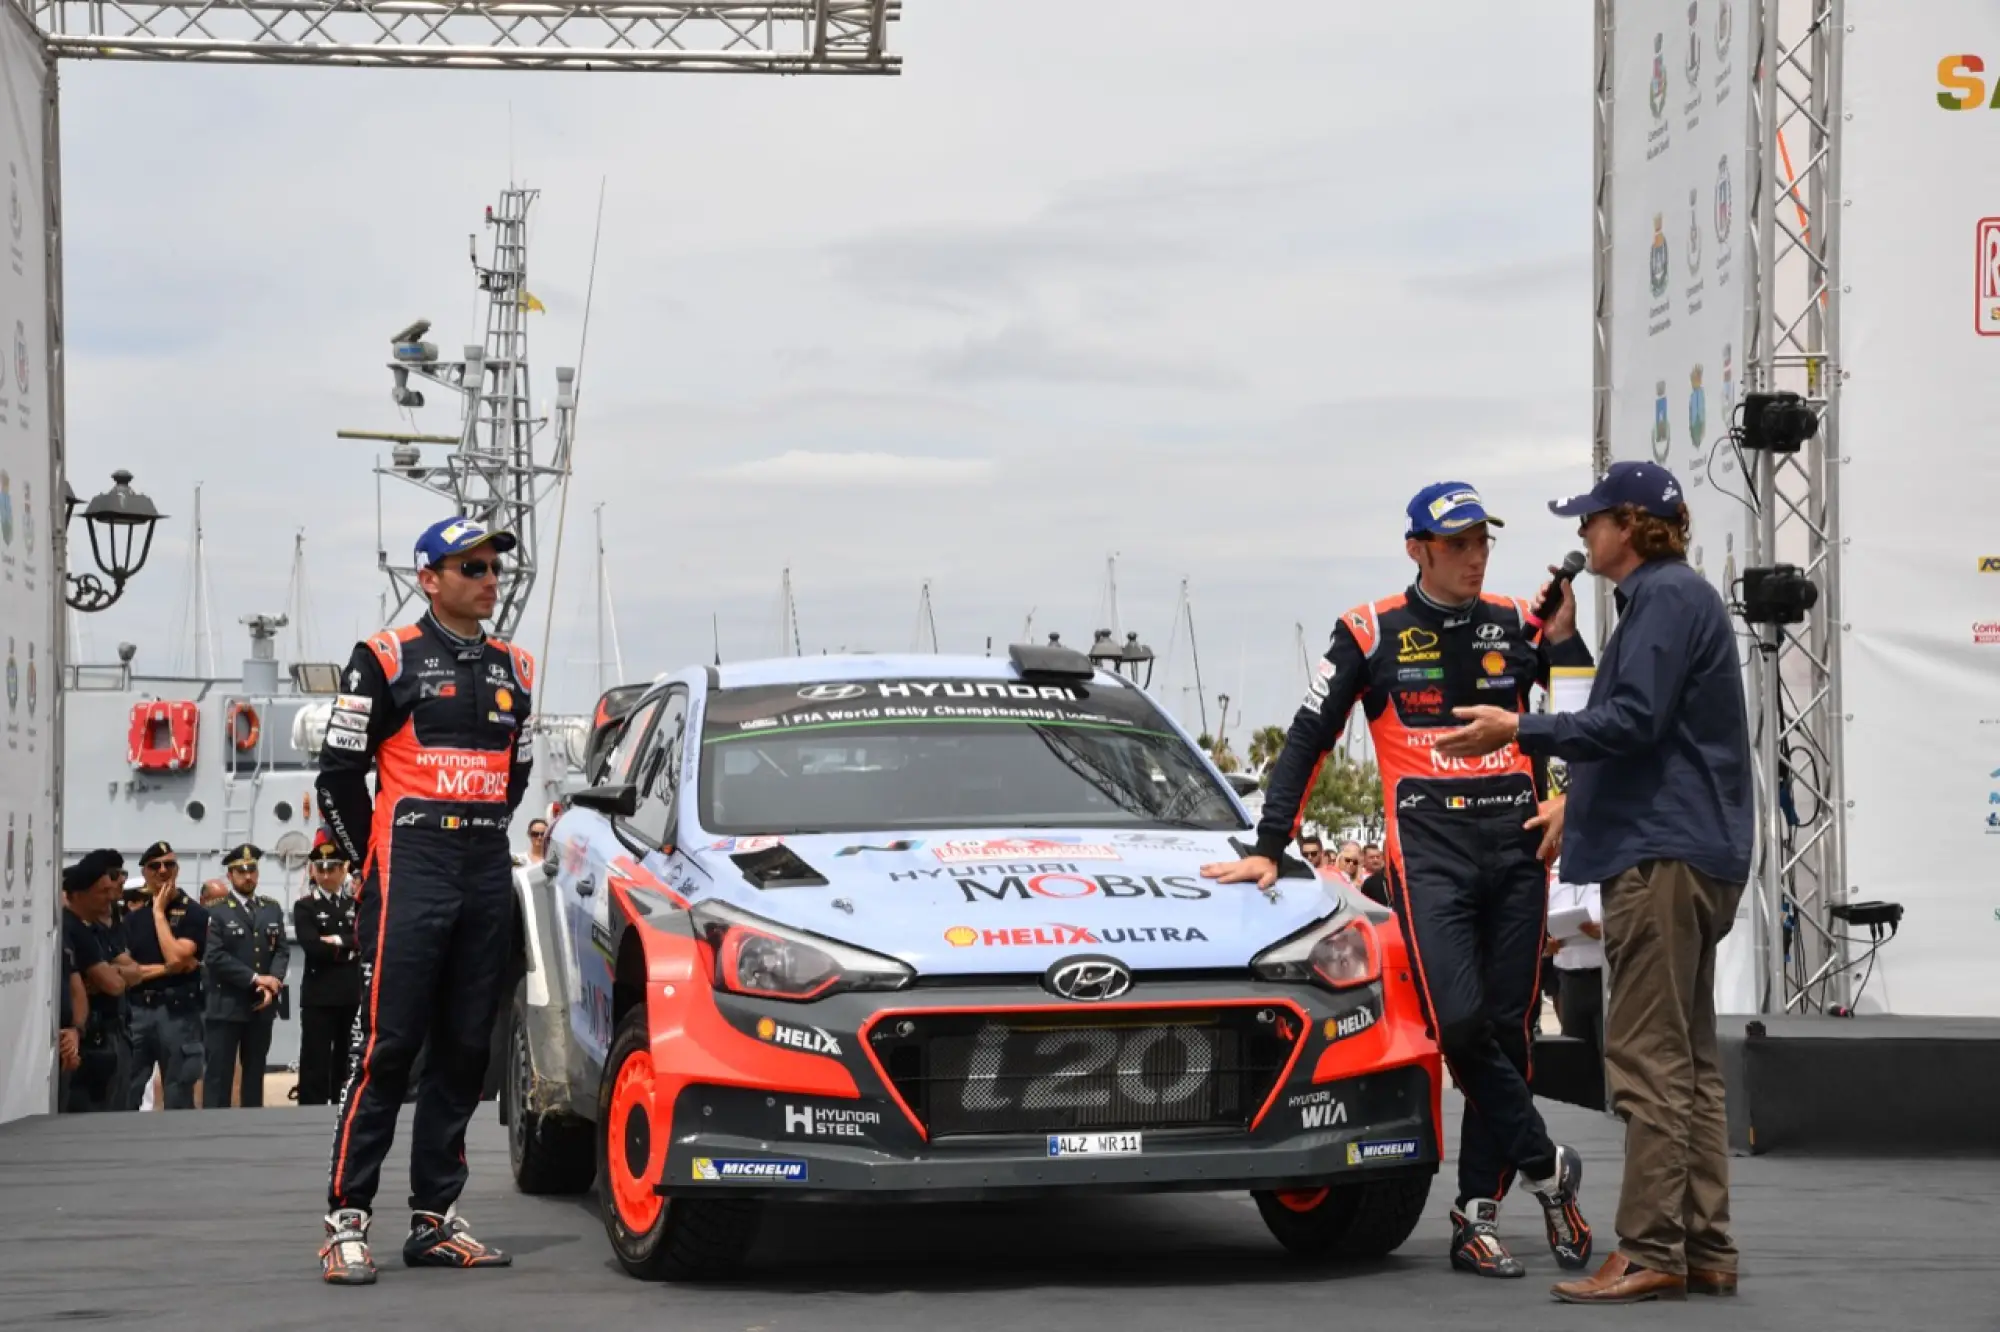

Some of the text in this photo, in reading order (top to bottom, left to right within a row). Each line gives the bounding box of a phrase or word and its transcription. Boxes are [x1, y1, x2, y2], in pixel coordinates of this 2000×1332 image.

[878, 683, 1076, 701] HYUNDAI
[793, 711, 823, 724] FIA
[827, 708, 879, 720] World
[884, 705, 928, 717] Rally
[933, 705, 1056, 719] Championship
[416, 753, 487, 768] HYUNDAI
[889, 863, 1080, 881] HYUNDAI
[955, 874, 1212, 902] MOBIS
[982, 922, 1209, 946] HELIX ULTRA
[1337, 1006, 1375, 1036] HELIX
[775, 1025, 843, 1056] HELIX
[1288, 1091, 1331, 1107] HYUNDAI
[815, 1108, 881, 1125] HYUNDAI
[1301, 1101, 1348, 1129] WIA
[816, 1122, 864, 1136] STEEL
[1060, 1136, 1088, 1152] ALZ
[1363, 1143, 1415, 1157] MICHELIN
[721, 1162, 801, 1175] MICHELIN
